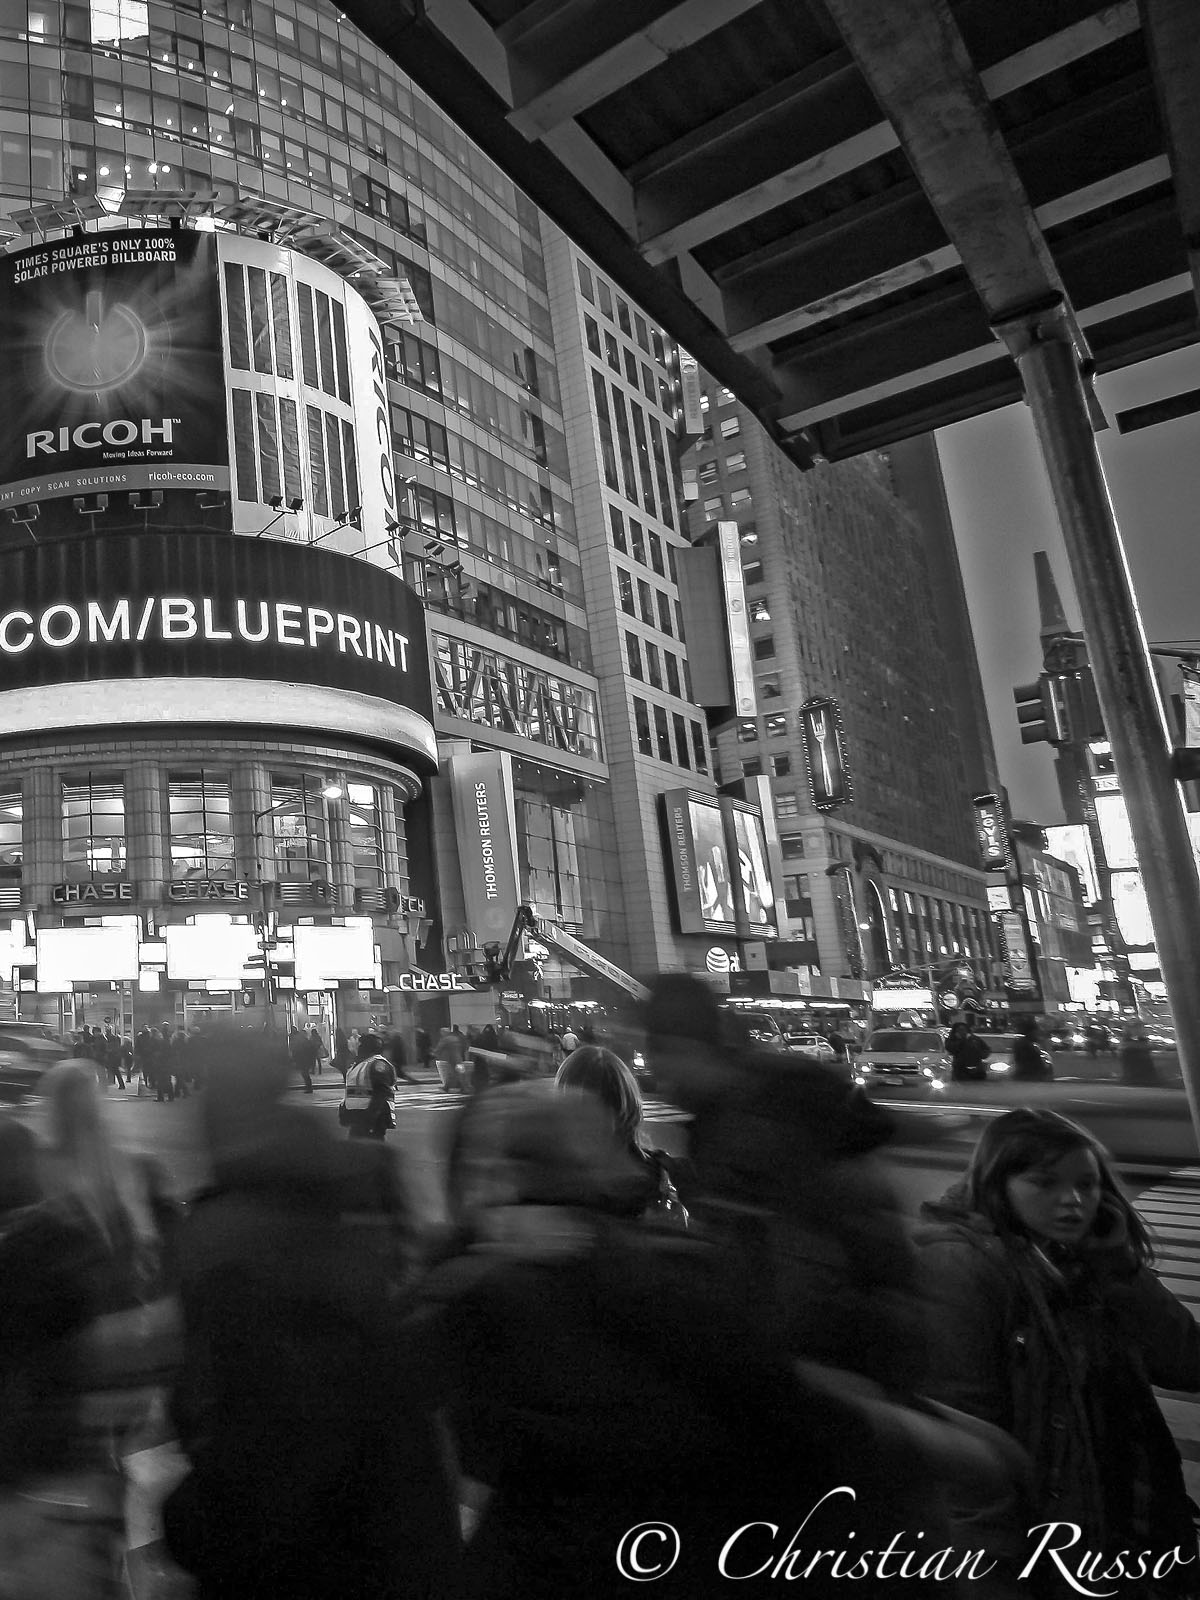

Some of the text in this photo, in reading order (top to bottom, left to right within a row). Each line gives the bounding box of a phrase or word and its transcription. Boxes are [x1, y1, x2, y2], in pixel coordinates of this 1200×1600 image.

[14, 251, 176, 284] SOLAR POWERED BILLBOARD
[15, 238, 175, 271] TIMES SQUARE'S ONLY 100%
[102, 451, 125, 459] Moving
[368, 326, 400, 565] RICOH
[20, 486, 41, 496] COPY
[48, 481, 70, 491] SCAN
[77, 475, 127, 486] SOLUTIONS
[149, 472, 215, 482] ricoh-eco.com
[475, 782, 499, 900] THOMSON REUTERS
[674, 807, 692, 893] THOMSON REUTERS
[53, 882, 134, 902] CHASE
[169, 881, 250, 900] CHASE
